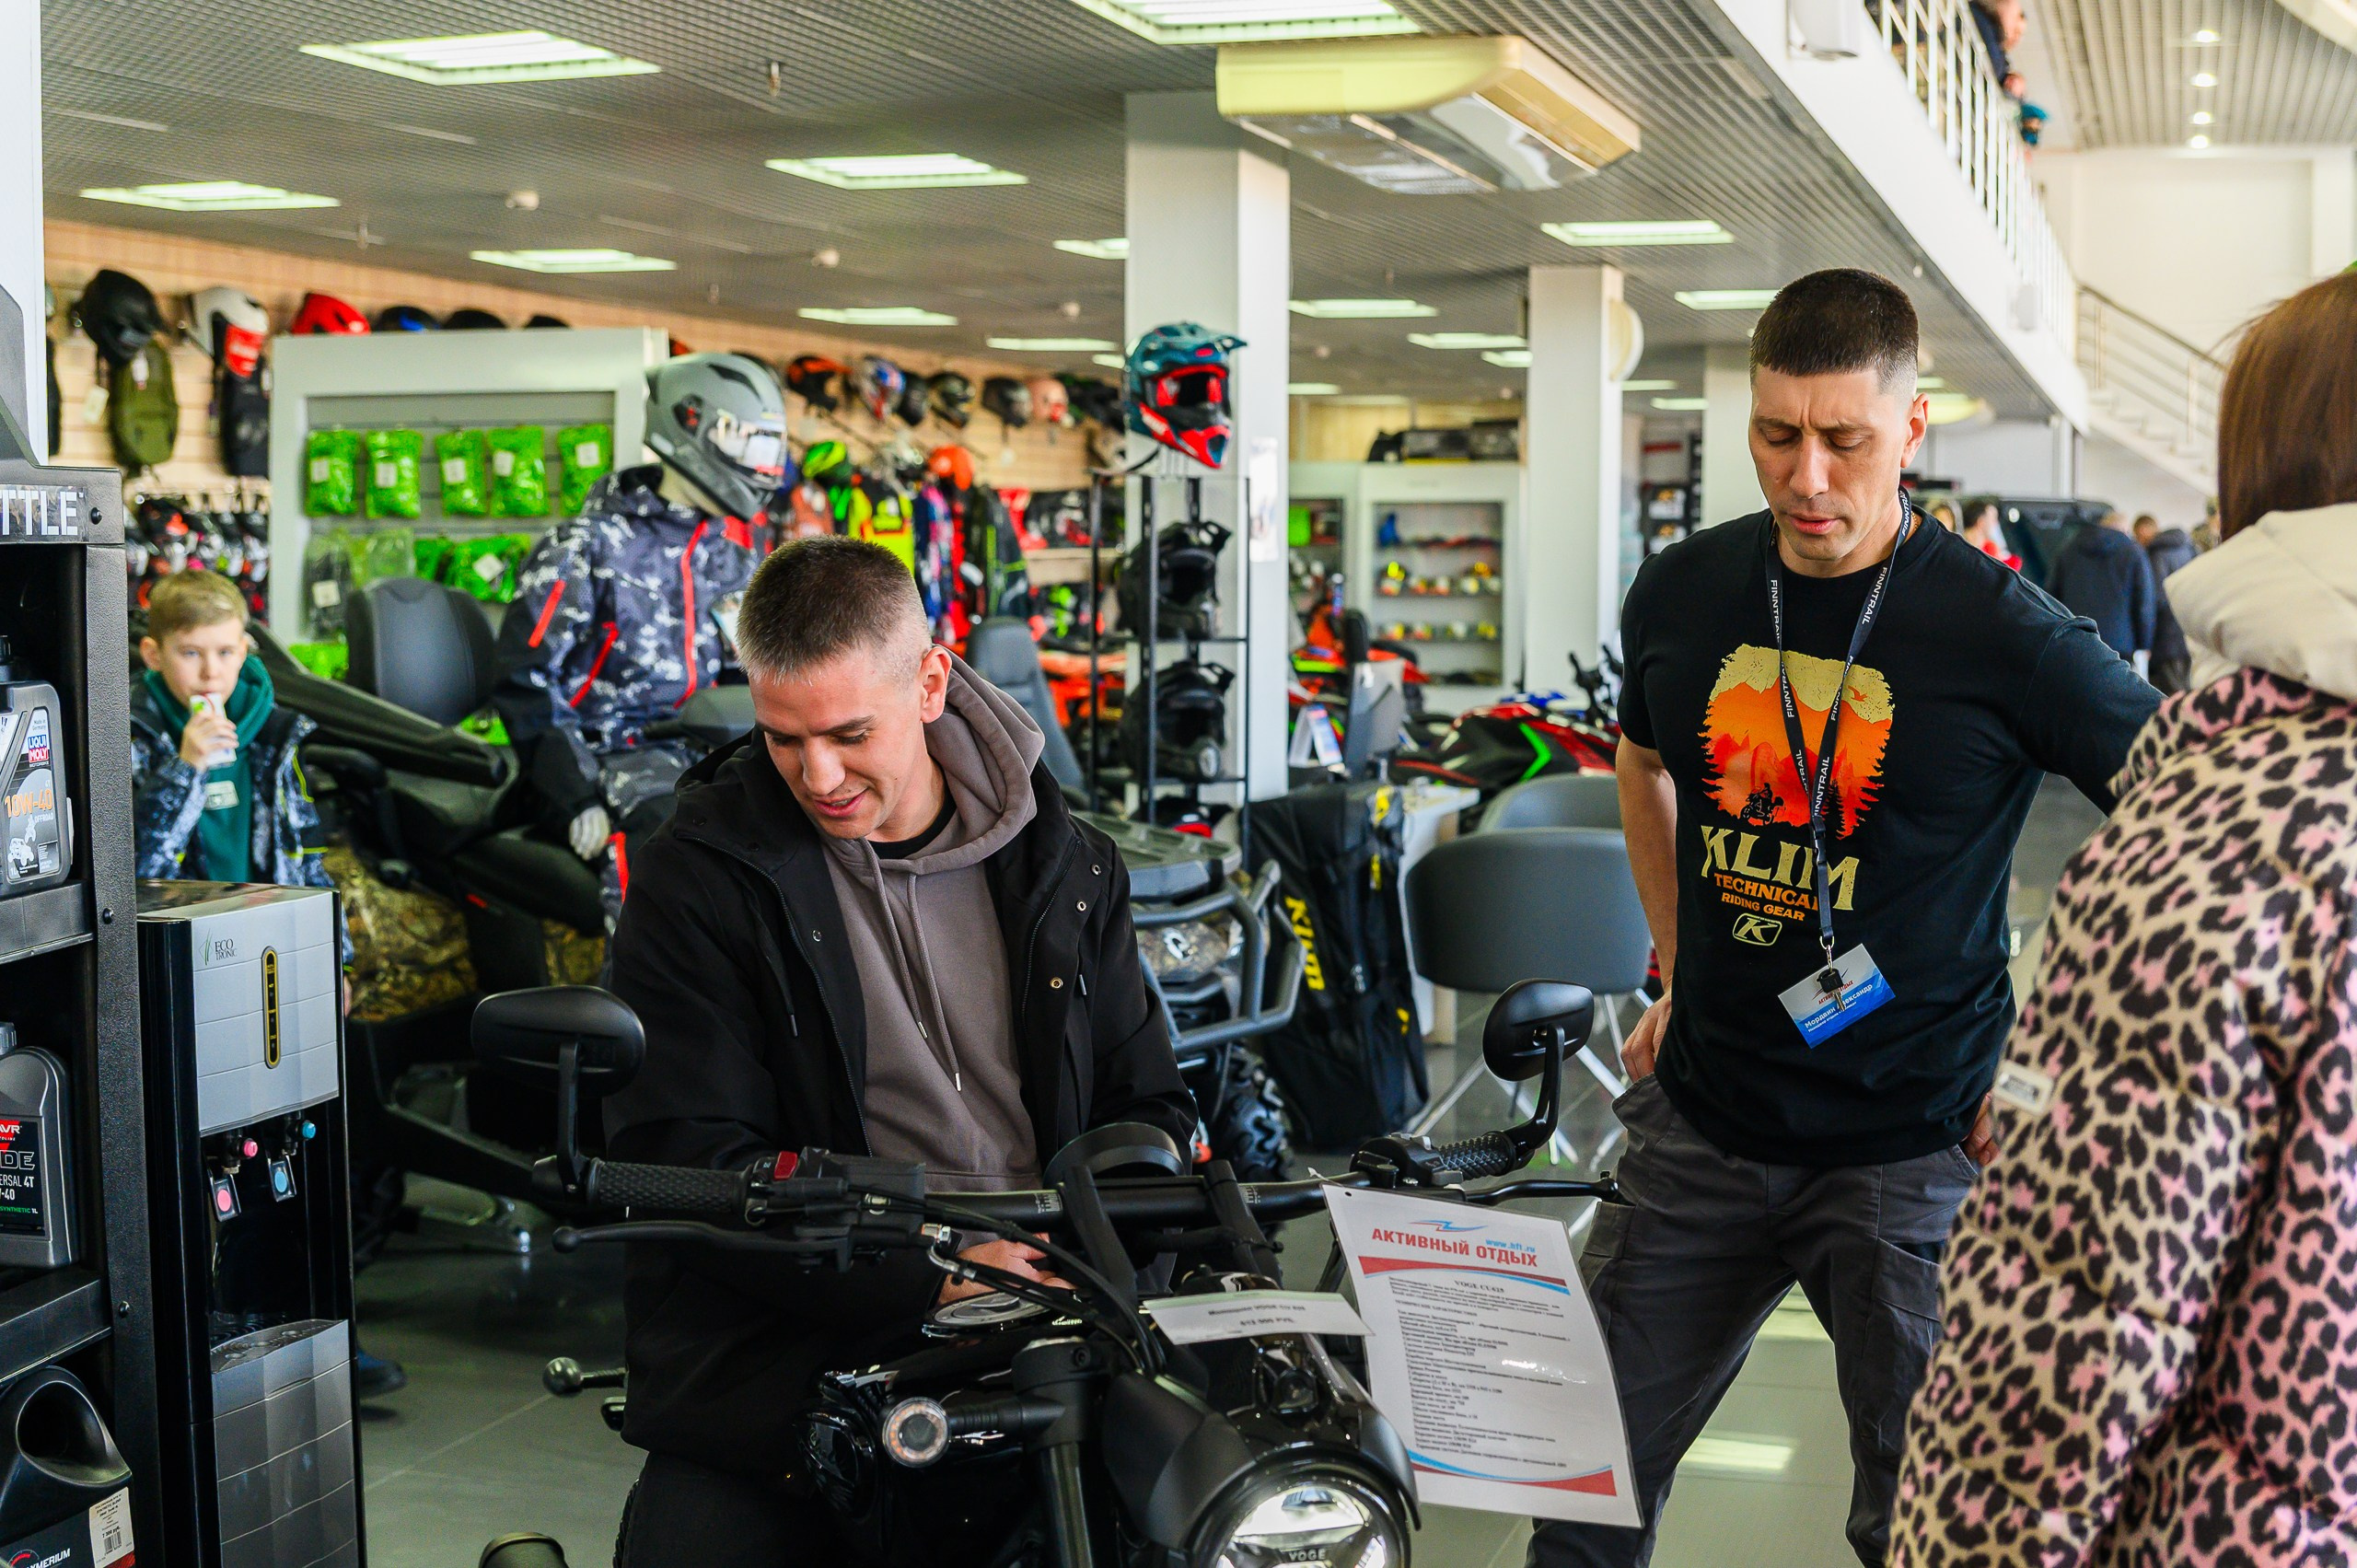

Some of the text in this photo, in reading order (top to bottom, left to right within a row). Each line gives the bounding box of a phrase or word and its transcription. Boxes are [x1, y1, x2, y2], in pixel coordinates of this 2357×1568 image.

[1862, 566, 1888, 625] FINNTRAIL
[29, 748, 49, 761] MOLY
[5, 789, 53, 818] 10W-40
[1701, 825, 1860, 912] KLIM
[1721, 892, 1805, 922] RIDING GEAR
[215, 938, 234, 953] ECO
[24, 1176, 34, 1188] 4T
[0, 1189, 16, 1201] -40
[1371, 1227, 1538, 1268] АКТИВНЫЙ ОТДЫХ
[1289, 1550, 1326, 1562] VOGE
